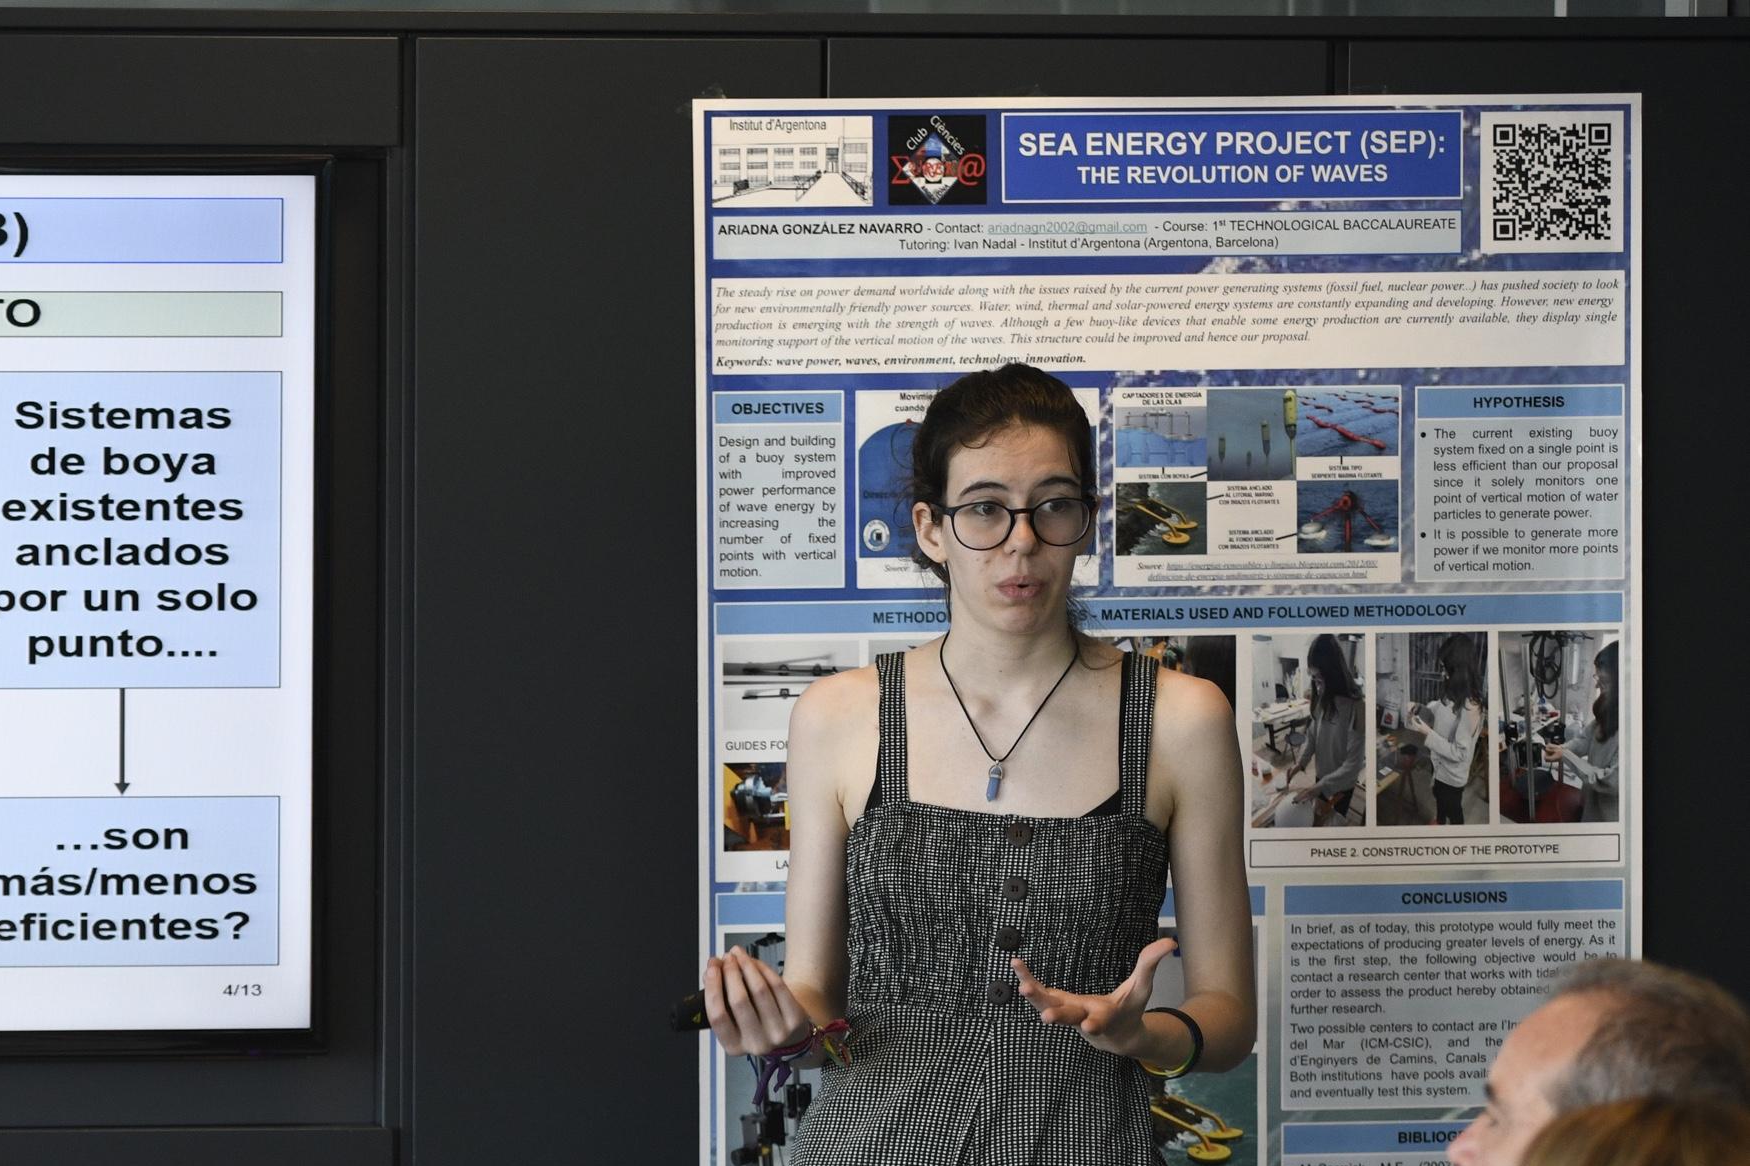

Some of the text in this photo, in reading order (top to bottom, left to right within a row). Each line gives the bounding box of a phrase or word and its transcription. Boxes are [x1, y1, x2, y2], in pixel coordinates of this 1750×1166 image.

[729, 119, 763, 131] Institut
[906, 127, 928, 151] Club
[1019, 130, 1444, 160] SEA ENERGY PROJECT (SEP):
[1077, 164, 1388, 184] THE REVOLUTION OF WAVES
[718, 224, 779, 236] ARIADNA
[782, 222, 856, 235] GONZÁLEZ
[859, 223, 923, 234] NAVARRO
[935, 223, 984, 234] Contact:
[988, 221, 1148, 236] ariadnagn2002@gmail.com
[1162, 221, 1208, 232] Course:
[1229, 219, 1340, 232] TECHNOLOGICAL
[1343, 218, 1456, 231] BACCALAUREATE
[899, 236, 1279, 253] Tutoring: Ivan Nadal Institut d'Argentona (Argentona, Barcelona)
[716, 356, 773, 369] Keywords:
[805, 358, 842, 368] power,
[846, 358, 881, 366] waves,
[884, 355, 956, 366] environment,
[1026, 353, 1086, 364] innovation.
[732, 402, 824, 415] OBJECTIVES
[1474, 396, 1565, 409] HYPOTHESIS
[15, 401, 232, 430] Sistemas
[1434, 427, 1619, 441] The current existing buoy
[719, 435, 836, 450] Design and building
[31, 447, 216, 483] de boya
[719, 452, 836, 466] of a buoy system
[718, 468, 836, 481] with improved
[719, 484, 836, 498] power performance
[2, 492, 244, 522] existentes
[719, 501, 836, 515] of wave energy by
[719, 517, 836, 531] increasing the
[720, 533, 836, 545] number of fixed
[16, 537, 230, 566] anclados
[720, 549, 837, 563] points with vertical
[720, 567, 762, 578] motion.
[84, 590, 140, 612] un
[157, 583, 258, 612] solo
[1102, 608, 1184, 621] MATERIALS
[1189, 607, 1229, 620] USED
[1233, 607, 1264, 619] AND
[1268, 606, 1350, 619] FOLLOWED
[1354, 604, 1467, 617] METHODOLOGY
[29, 630, 217, 665] punto....
[725, 741, 768, 751] GUIDES
[57, 828, 188, 851] ...son
[1311, 848, 1347, 858] PHASE
[1362, 846, 1450, 858] CONSTRUCTION
[1452, 846, 1468, 856] OF
[1470, 845, 1492, 855] THE
[1494, 844, 1560, 855] PROTOTYPE
[1402, 891, 1508, 905] CONCLUSIONS
[223, 984, 262, 996] 4/13
[1398, 1131, 1461, 1144] BIBLIOG
